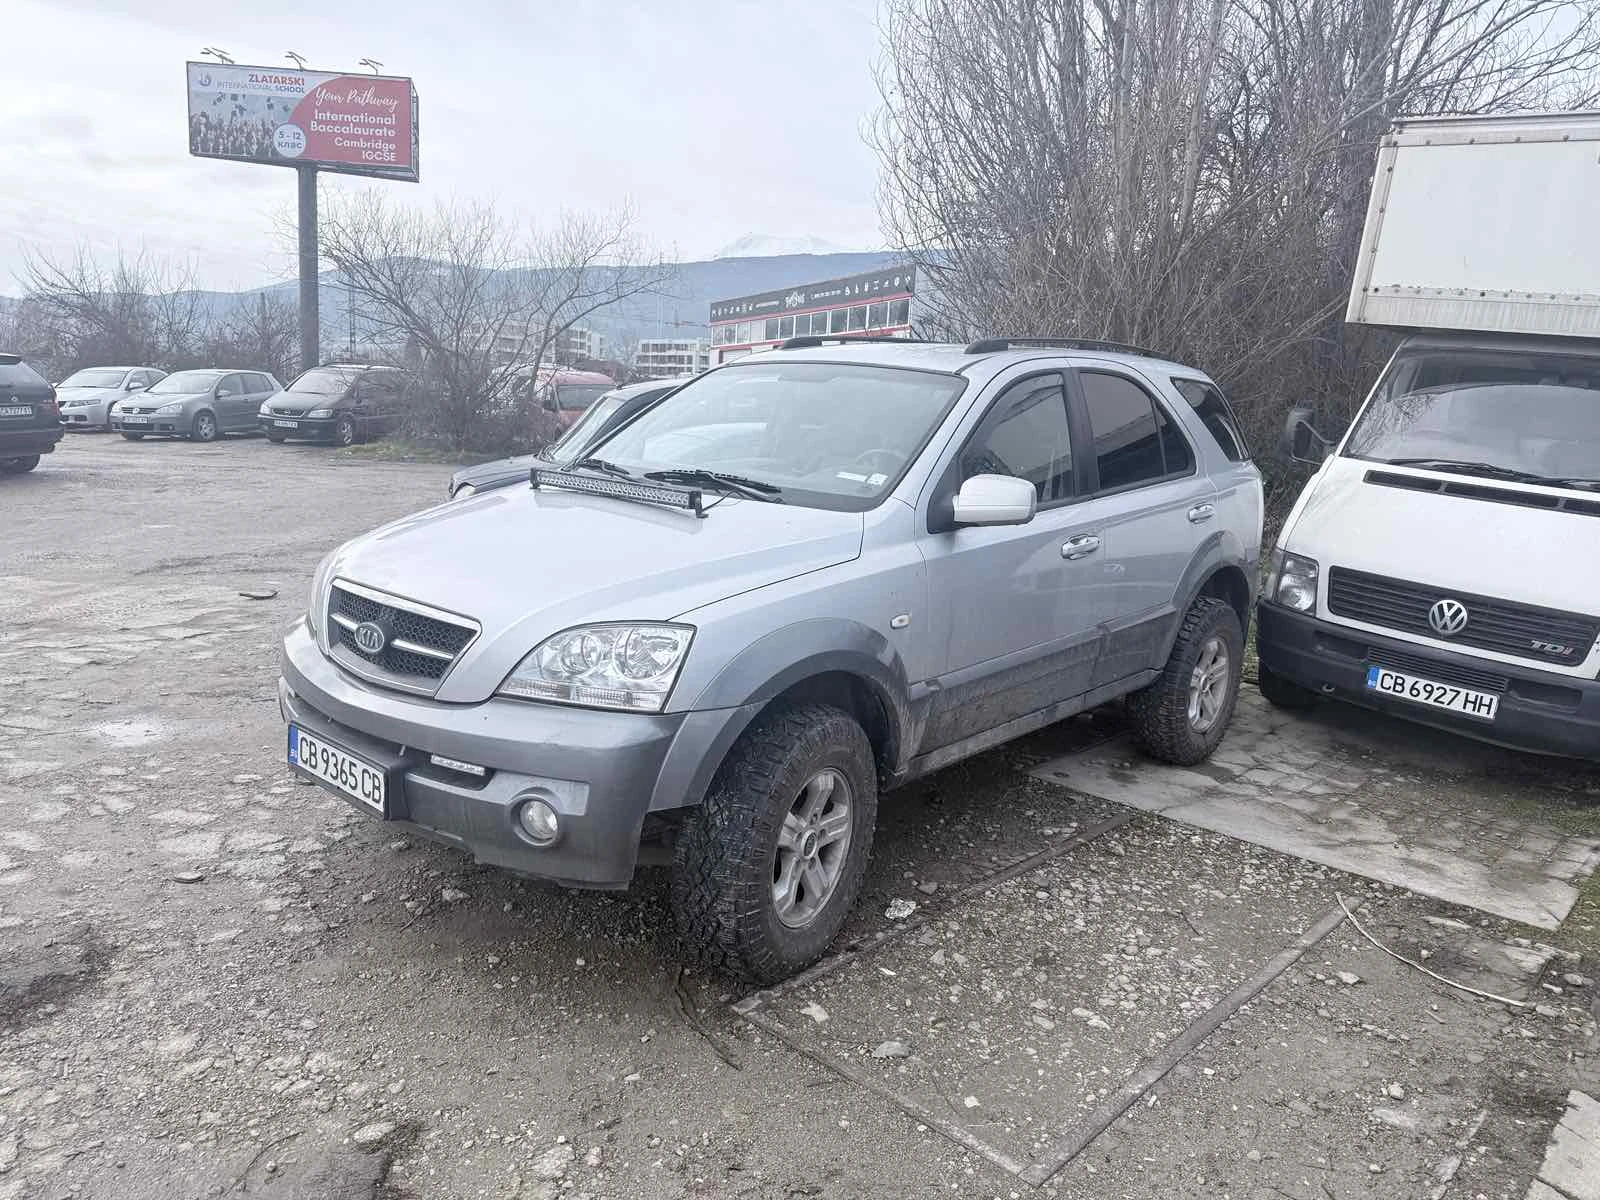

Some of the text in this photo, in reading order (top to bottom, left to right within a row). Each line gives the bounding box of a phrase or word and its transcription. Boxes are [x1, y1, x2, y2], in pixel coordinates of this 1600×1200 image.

[248, 74, 304, 86] ZLATARSKI
[275, 85, 304, 94] SCHOOL
[315, 86, 398, 113] Your Pathway
[314, 109, 396, 125] International
[334, 137, 396, 152] Cambridge
[362, 151, 397, 161] IGCSE
[359, 627, 379, 649] KIA
[1380, 673, 1493, 715] CB 6927 HH
[299, 736, 382, 804] CB 9365 CB
